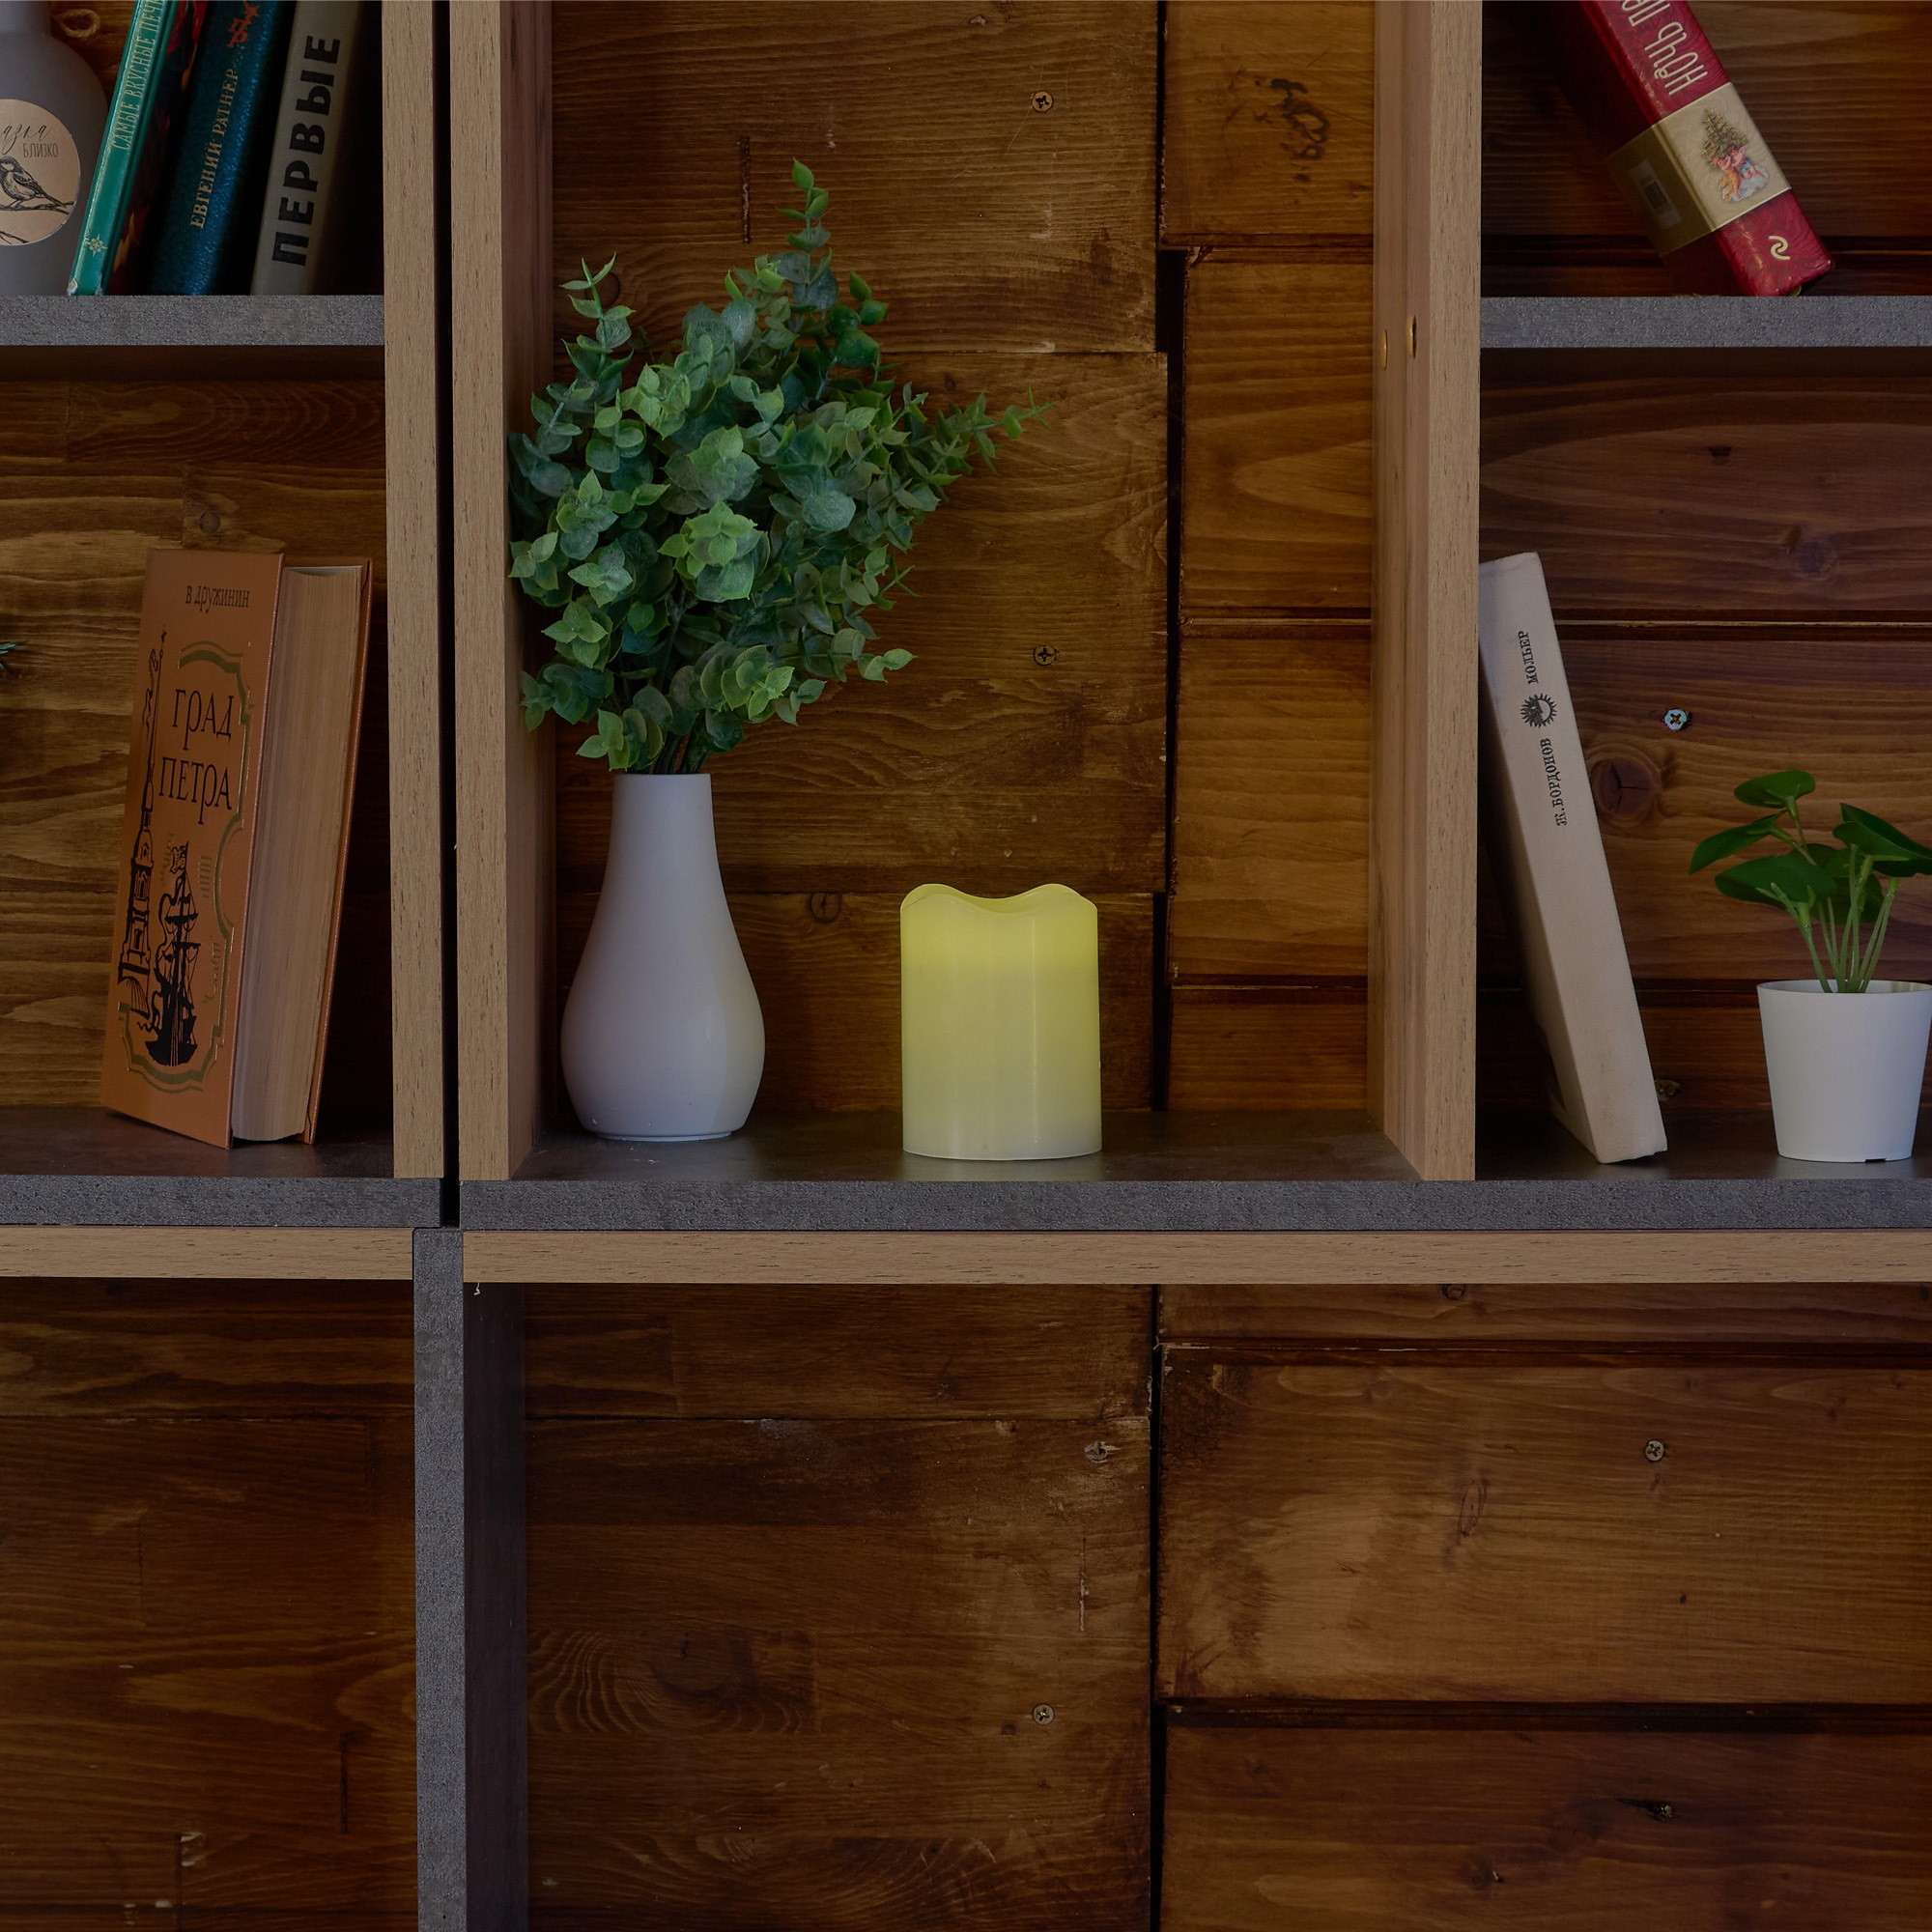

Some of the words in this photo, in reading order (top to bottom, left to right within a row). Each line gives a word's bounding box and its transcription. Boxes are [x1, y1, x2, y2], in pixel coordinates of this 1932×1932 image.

[124, 36, 156, 99] ВКУСНЫЕ
[1644, 21, 1708, 96] НОЧЬ
[0, 124, 53, 156] азка
[23, 143, 59, 157] БЛИЗКО
[111, 101, 140, 150] САМЫЕ
[190, 140, 222, 229] ЕВГЕНИЙ
[212, 68, 239, 136] РАТНЕР
[271, 35, 341, 267] ПЕРВЫЕ
[1518, 630, 1539, 685] МОЛЬЕР
[172, 689, 235, 751] ГРАД
[158, 756, 232, 825] ПЕТРА
